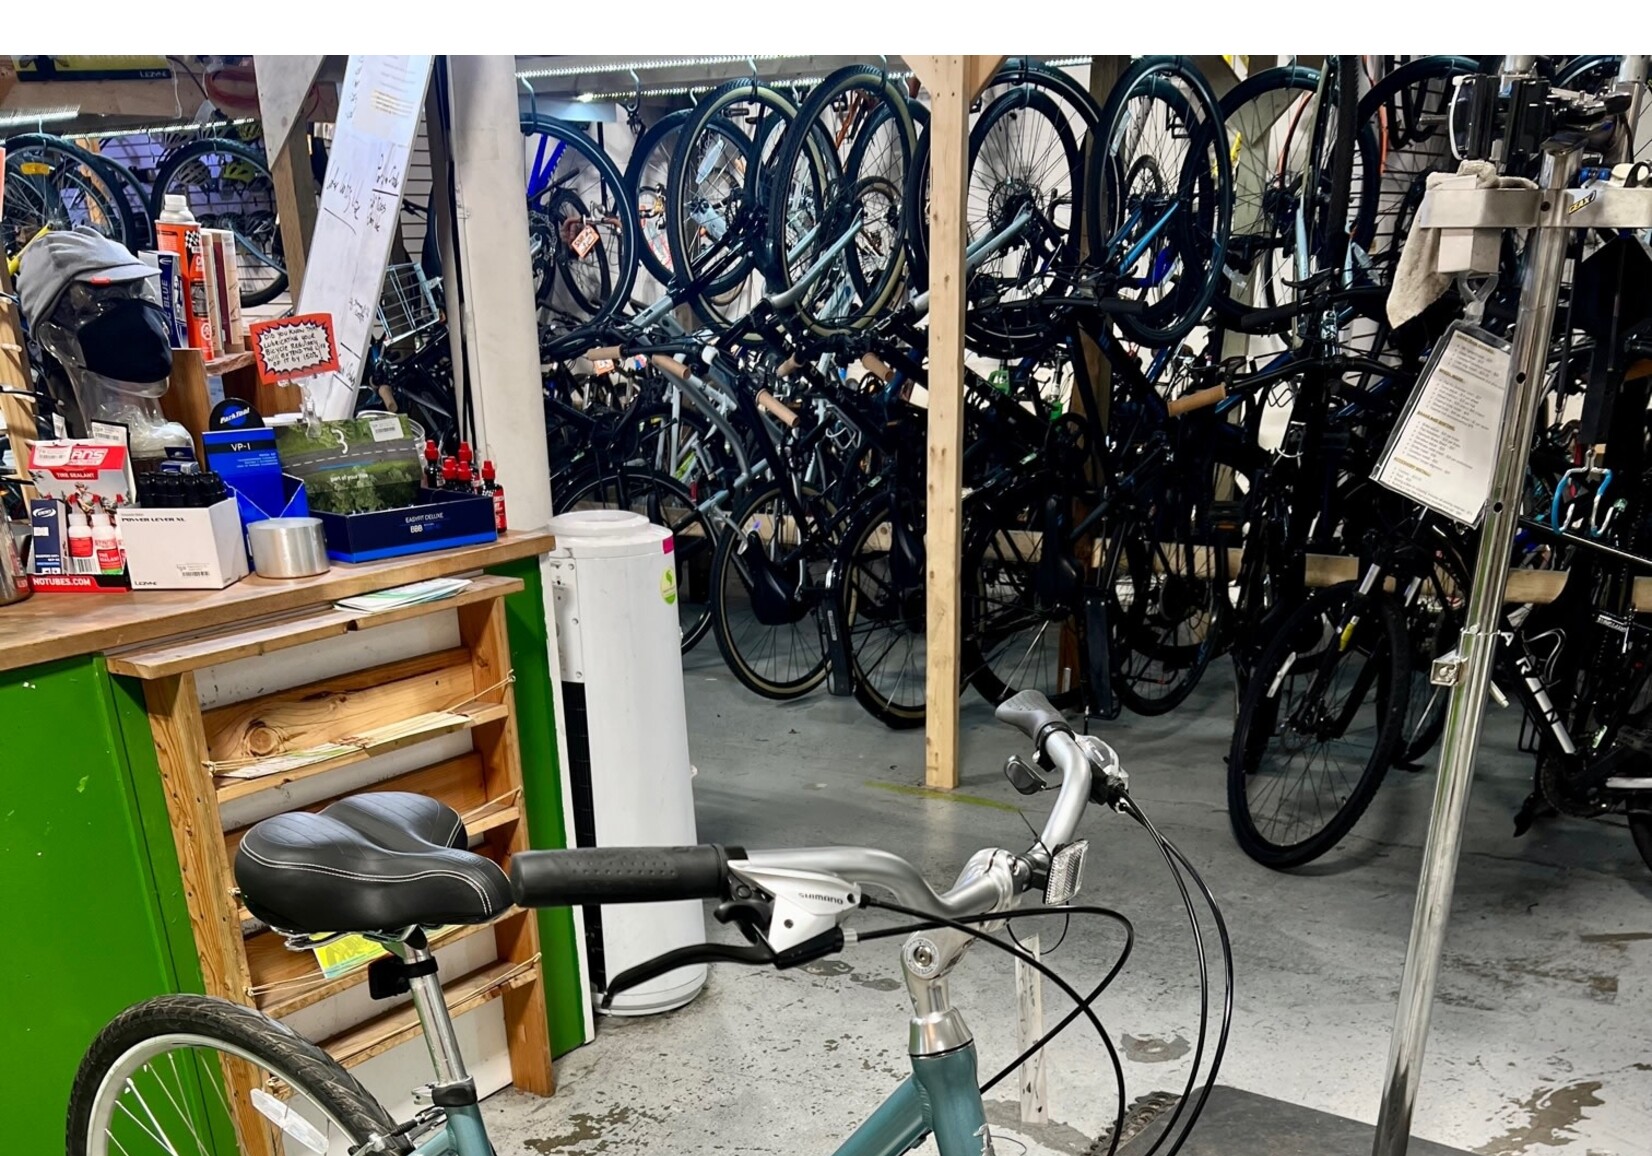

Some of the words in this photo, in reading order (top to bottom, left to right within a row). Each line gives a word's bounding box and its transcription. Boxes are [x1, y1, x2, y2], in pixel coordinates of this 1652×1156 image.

[162, 279, 170, 308] BLUE
[424, 512, 444, 520] DELUXE
[33, 577, 91, 586] NOTUBES.COM
[799, 892, 844, 905] SHIMANO
